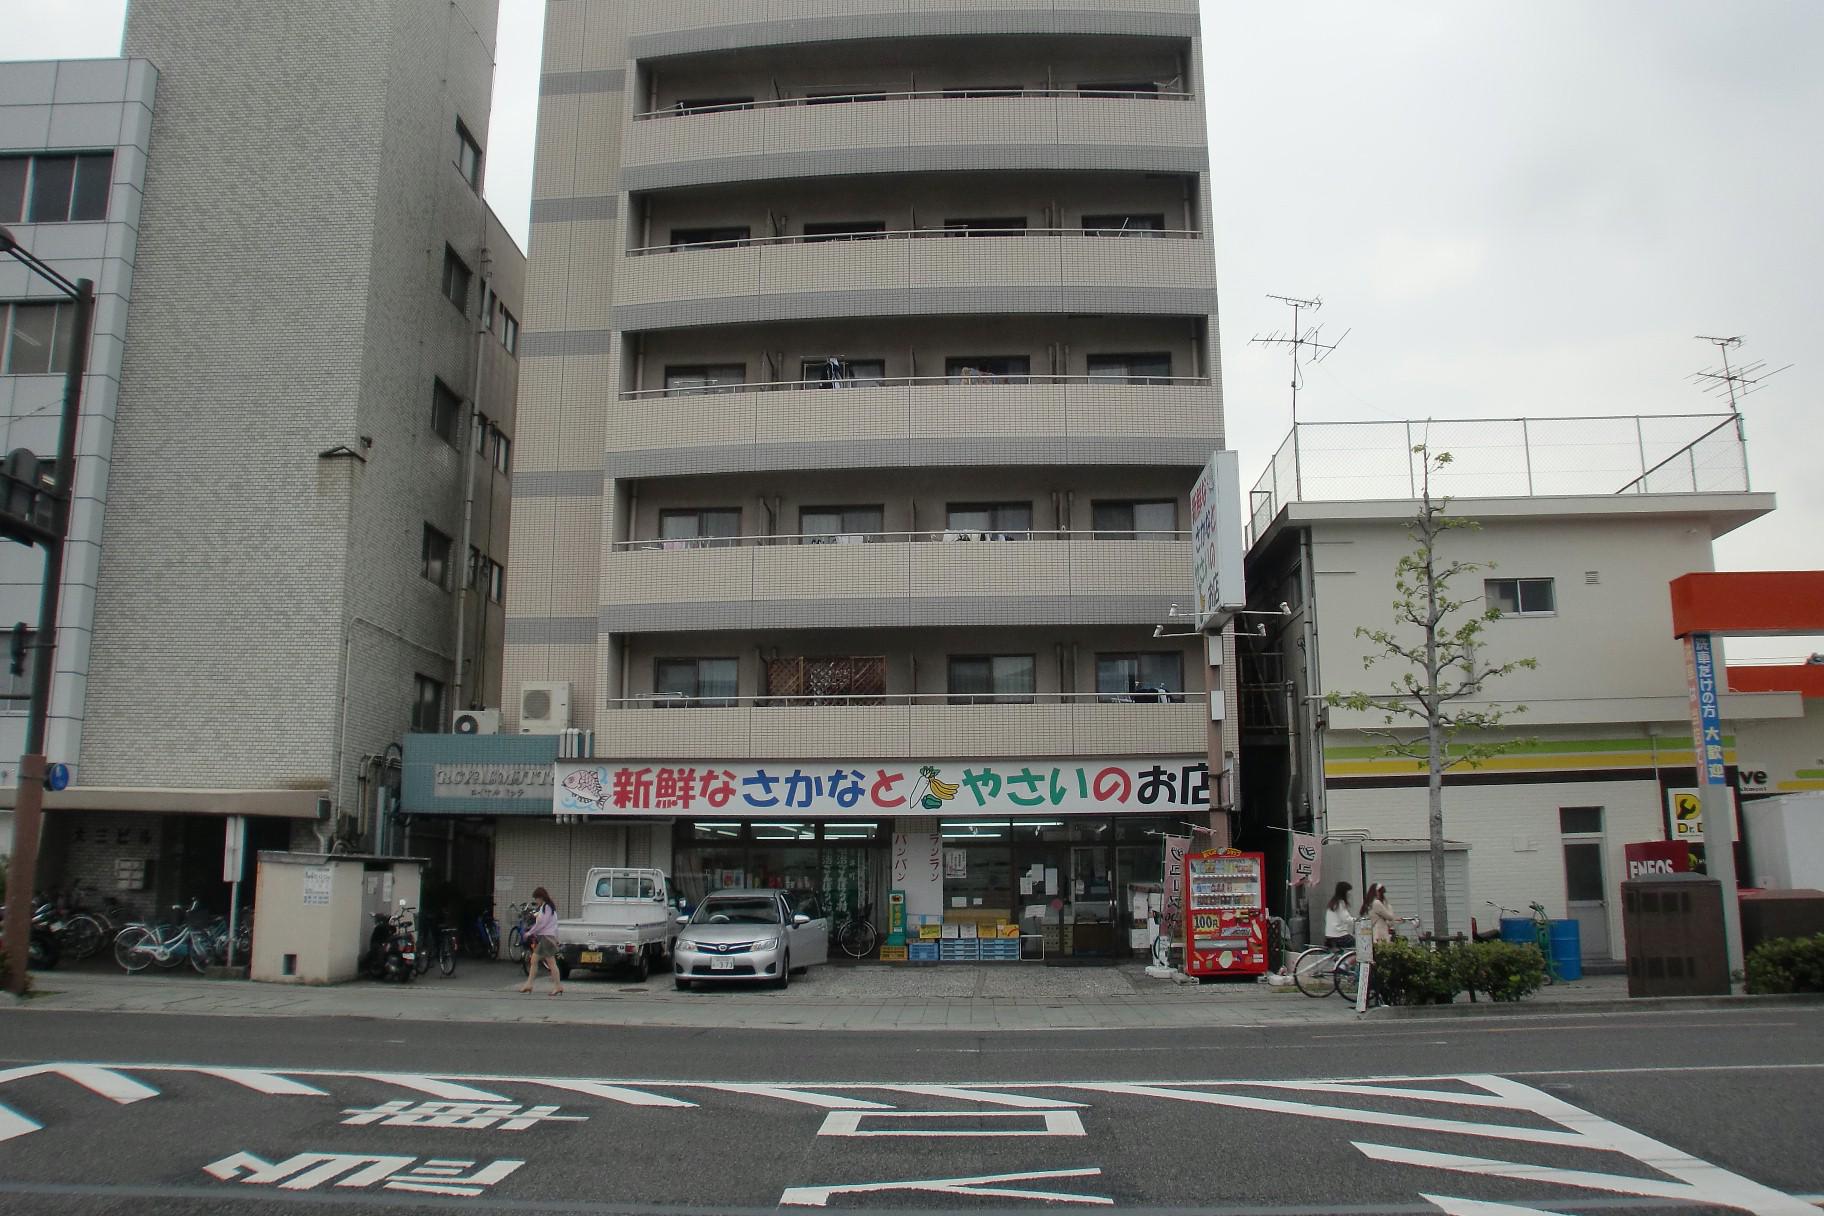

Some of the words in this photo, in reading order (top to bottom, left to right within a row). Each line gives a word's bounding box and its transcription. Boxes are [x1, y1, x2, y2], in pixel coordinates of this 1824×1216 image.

[1704, 726, 1725, 778] 大歓迎
[613, 767, 907, 809] 新鮮なさかなと
[962, 763, 1209, 807] やさいのお店
[929, 834, 939, 882] ランラン
[1630, 860, 1674, 879] ENEOS
